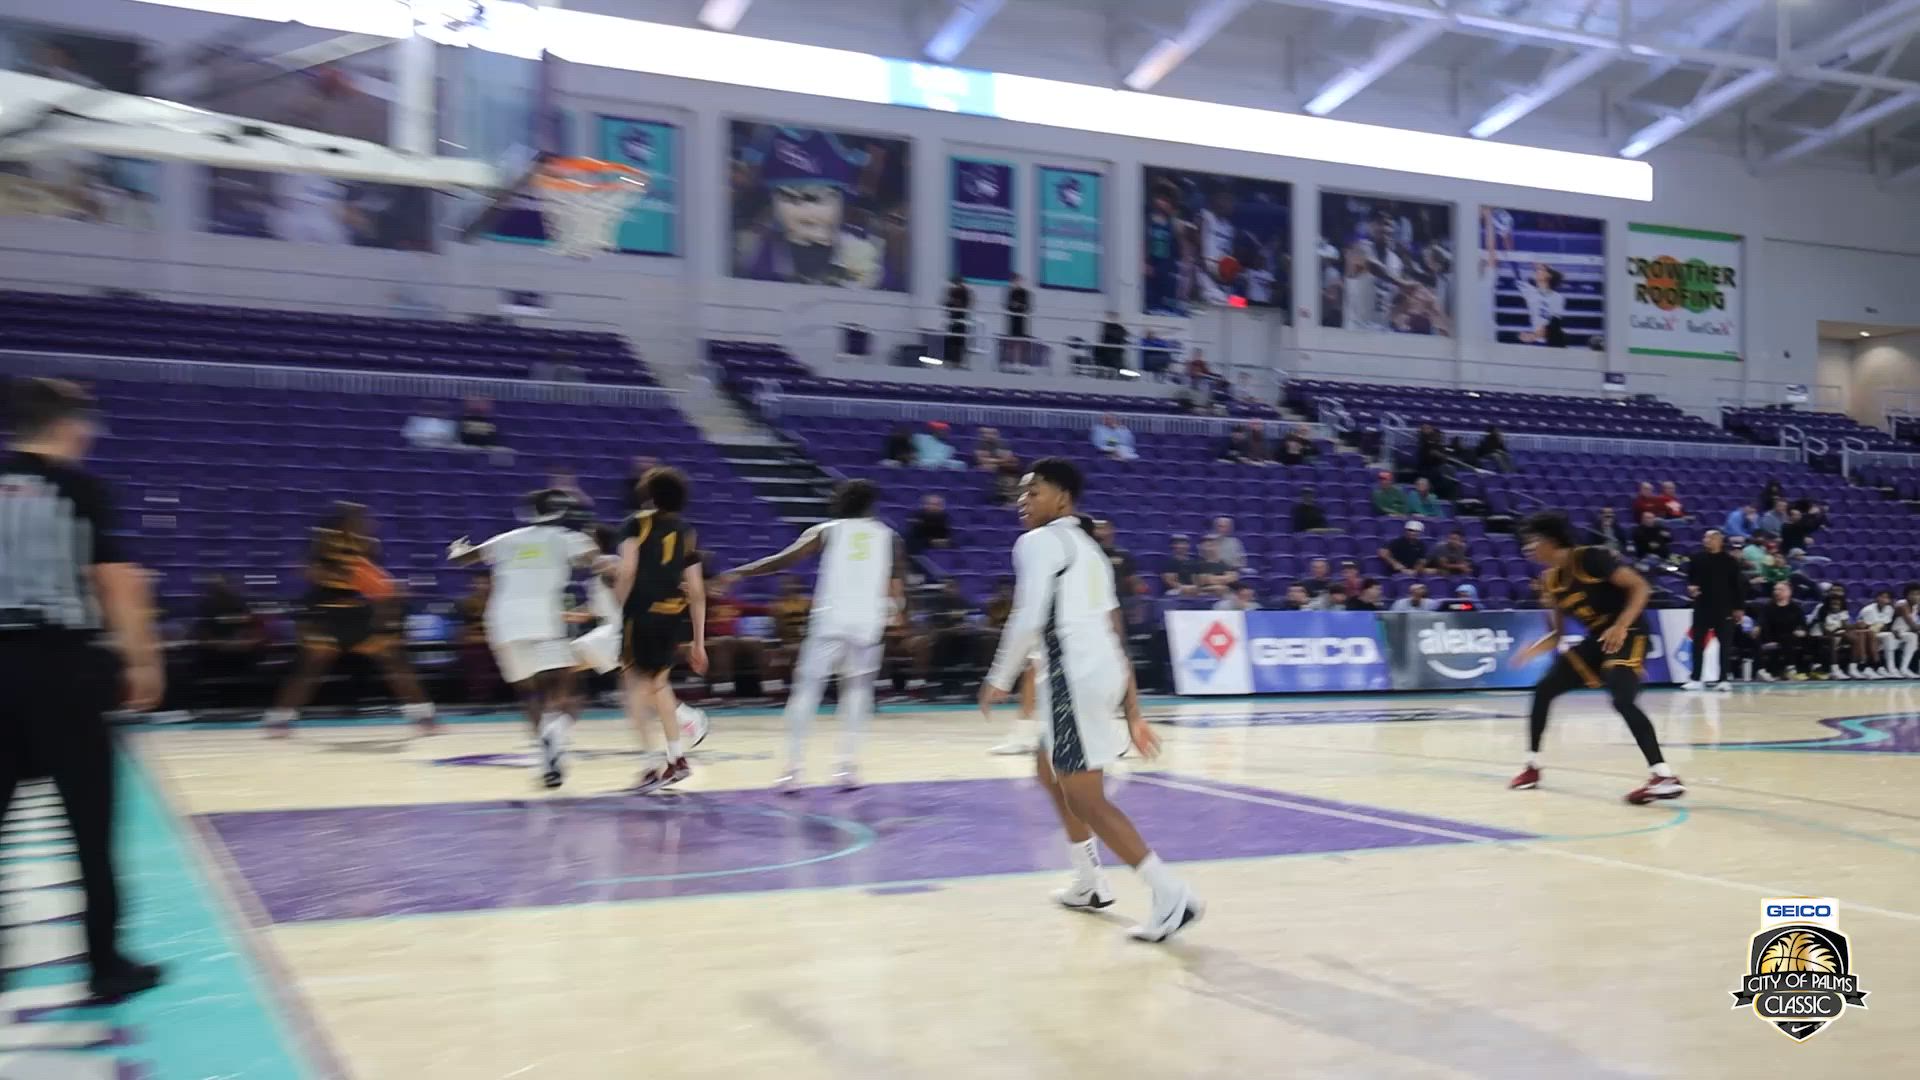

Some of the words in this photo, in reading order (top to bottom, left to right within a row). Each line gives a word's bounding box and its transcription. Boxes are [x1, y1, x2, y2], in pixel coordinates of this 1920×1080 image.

[1626, 256, 1736, 289] CROWTHER
[1634, 283, 1725, 310] ROOFING
[662, 531, 677, 565] 1
[1251, 636, 1378, 665] GEICO
[1417, 621, 1515, 655] alexa+
